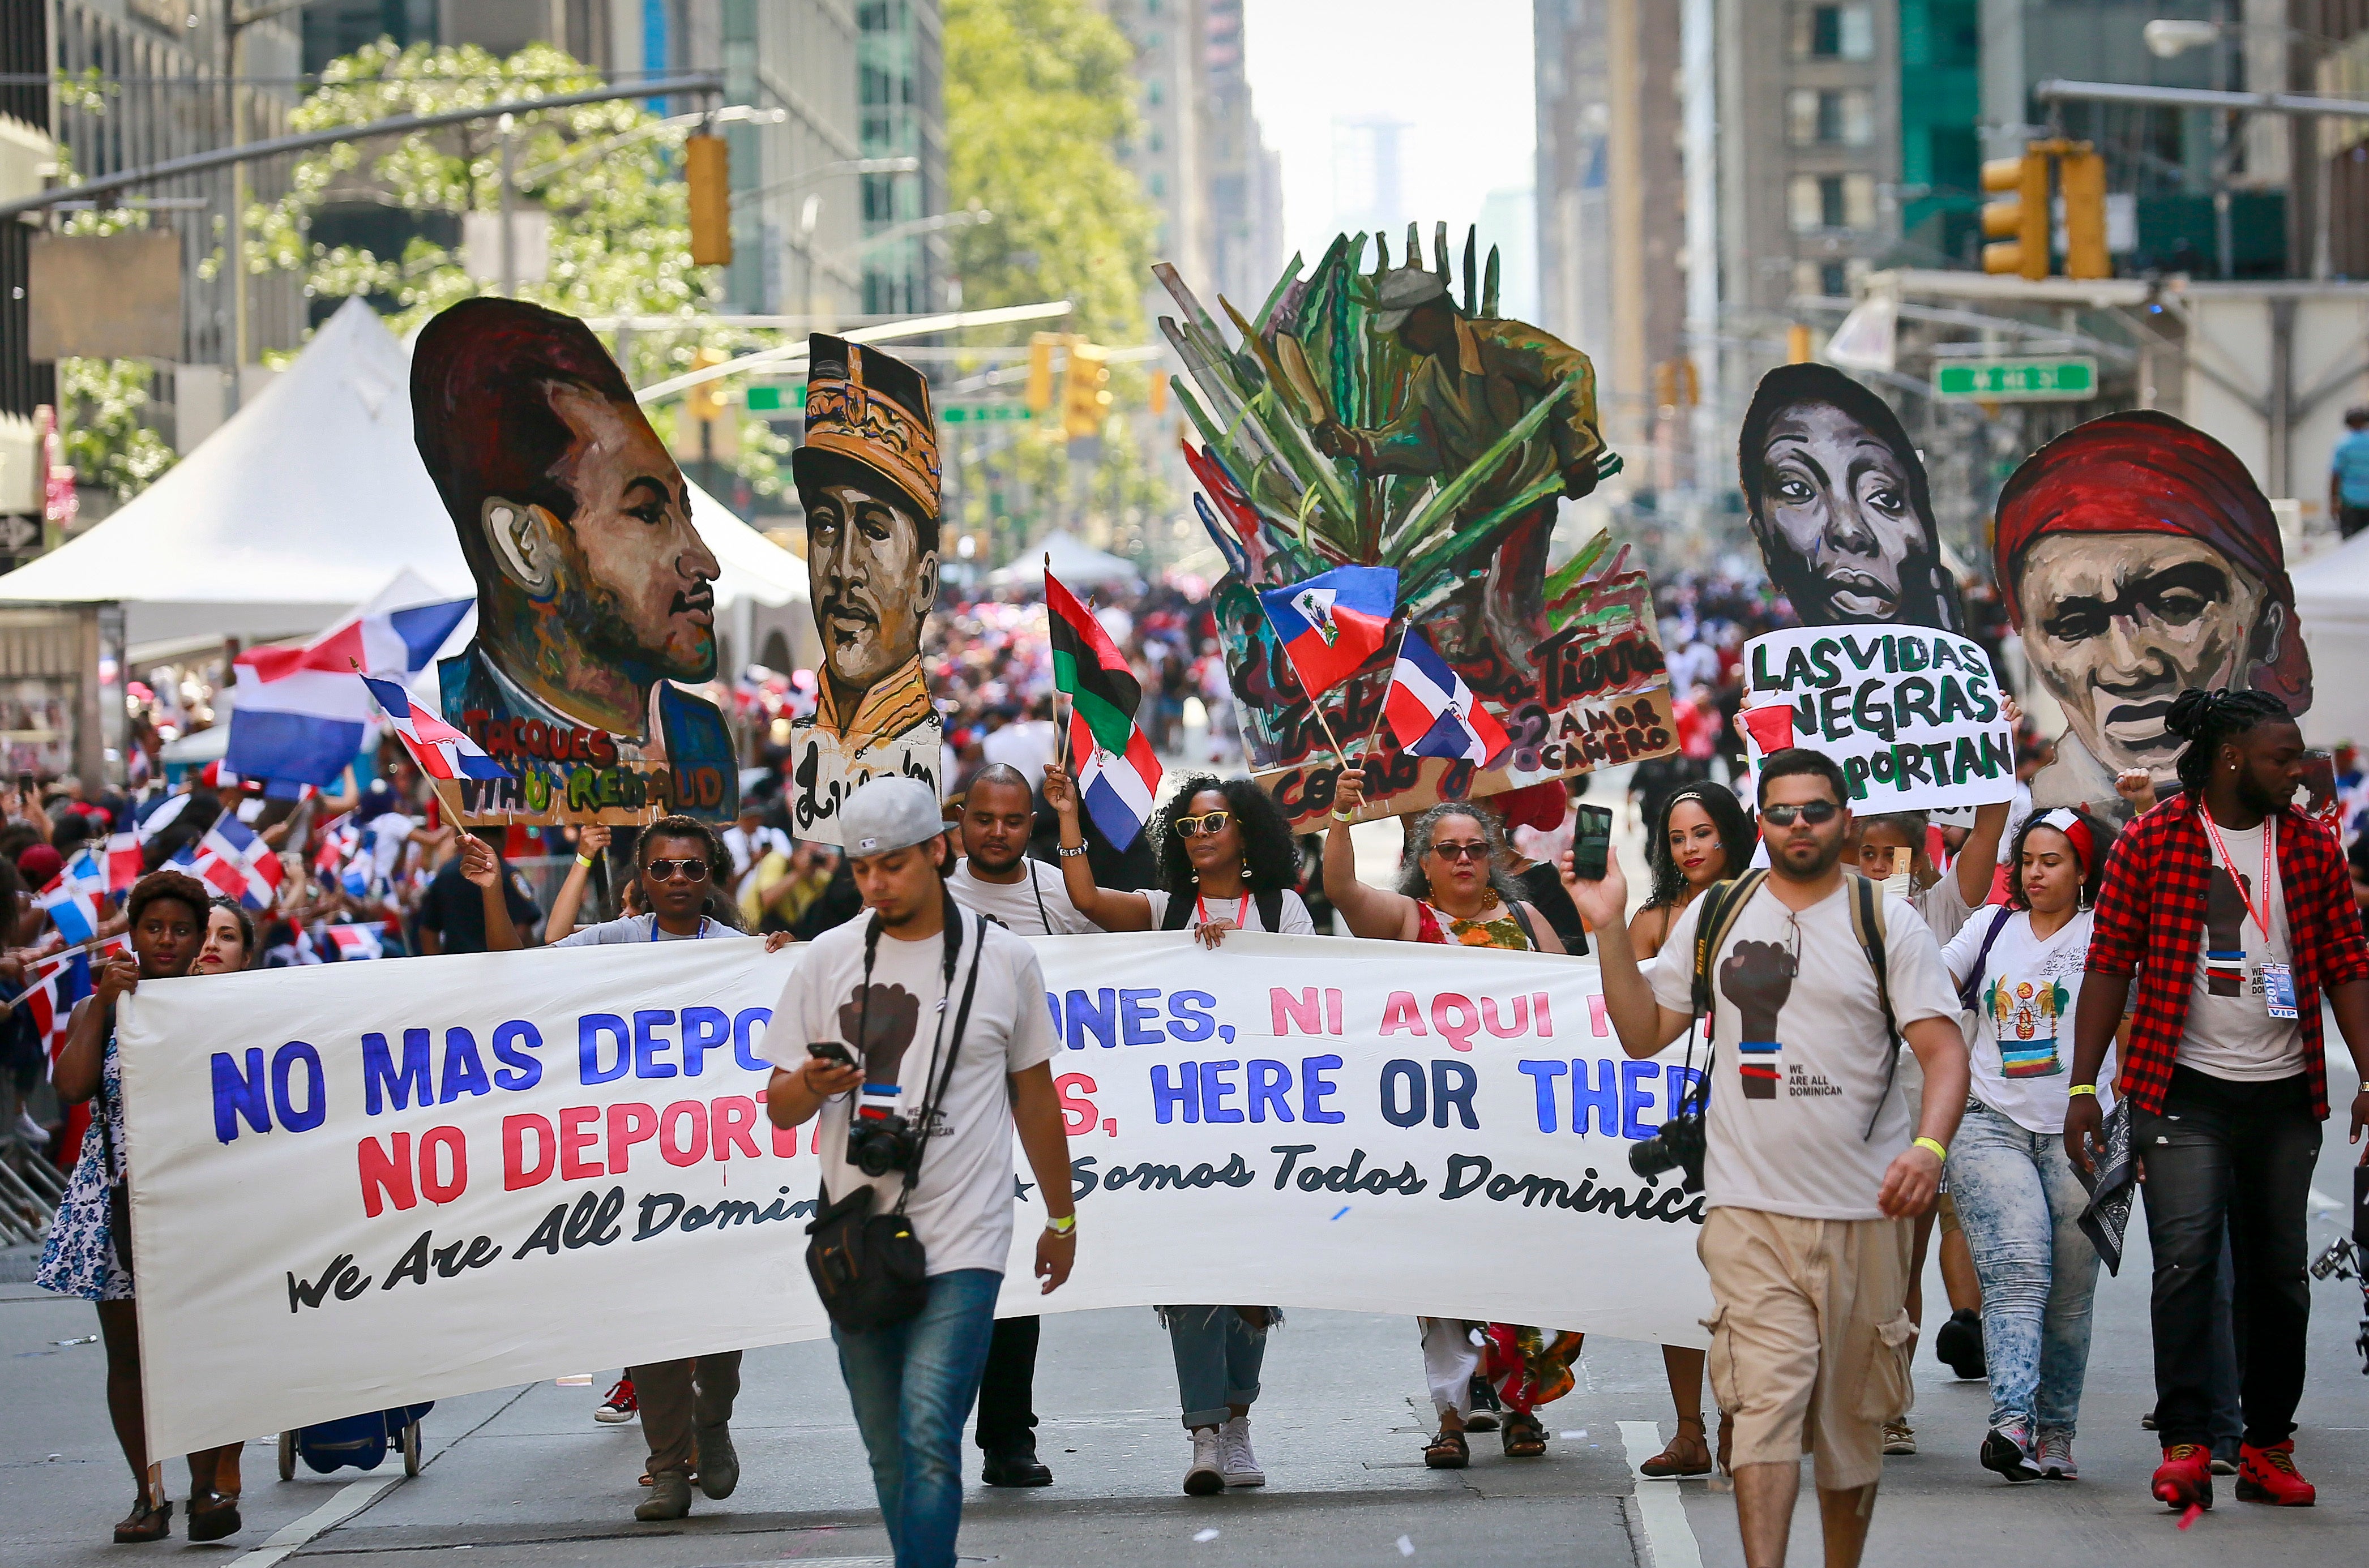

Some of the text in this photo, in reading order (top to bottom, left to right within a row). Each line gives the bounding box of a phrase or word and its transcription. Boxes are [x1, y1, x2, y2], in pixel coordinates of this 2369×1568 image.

[1559, 697, 1661, 740] AMOR
[1792, 675, 1998, 742] NEGRAS
[2265, 974, 2278, 1004] 2017
[211, 1040, 326, 1144] NO
[361, 1019, 544, 1116] MAS
[1269, 987, 1343, 1036] NI
[1379, 991, 1554, 1052] AQUI
[1789, 1064, 1803, 1074] WE
[1790, 1076, 1829, 1085] ARE ALL
[1790, 1086, 1842, 1096] DOMINICAN
[358, 1125, 468, 1218] NO
[1150, 1054, 1345, 1124] HERE
[1380, 1059, 1480, 1130] OR
[286, 1253, 372, 1314] We
[381, 1230, 502, 1291] Are
[512, 1186, 626, 1259] All
[1069, 1153, 1255, 1202] Somos
[1271, 1144, 1428, 1196] Todos
